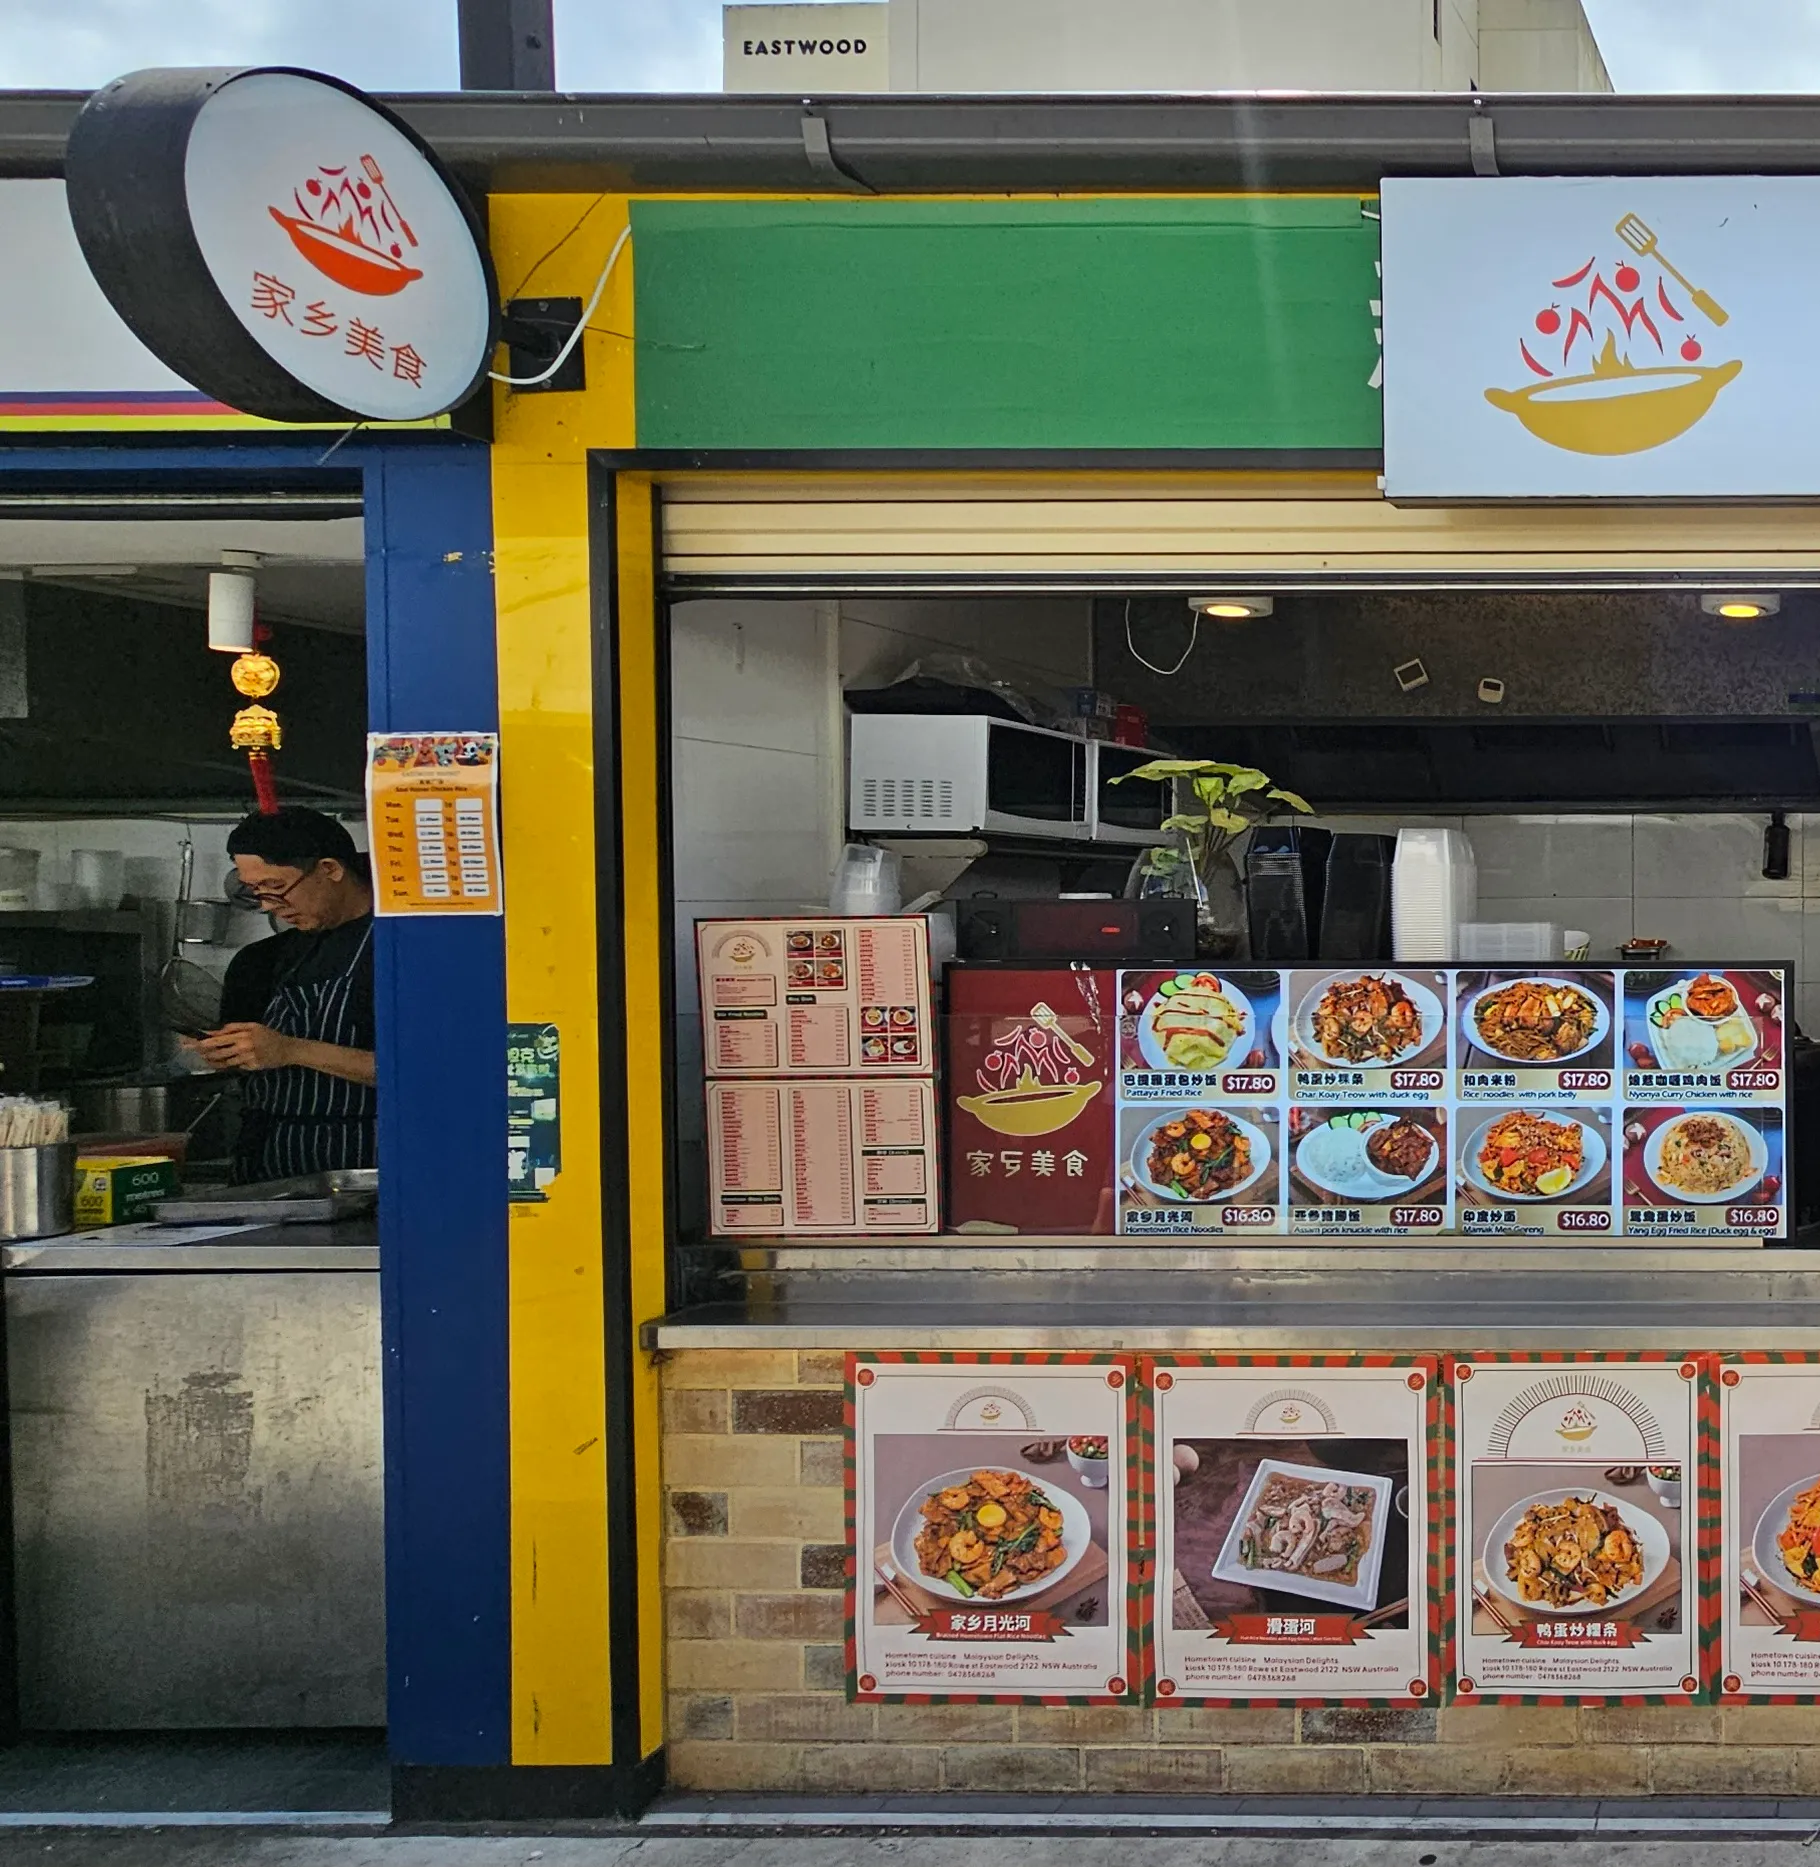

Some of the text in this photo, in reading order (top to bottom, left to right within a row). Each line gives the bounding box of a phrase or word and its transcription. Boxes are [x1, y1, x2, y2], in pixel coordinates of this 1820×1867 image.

[743, 39, 867, 55] EASTWOOD
[251, 270, 428, 389] 家乡美食
[1227, 1077, 1272, 1089] $17.80
[1395, 1073, 1440, 1086] $17.80
[1464, 1075, 1516, 1086] 扣肉米粉
[1563, 1073, 1608, 1086] $17.80
[1731, 1074, 1776, 1087] $17.80
[1126, 1089, 1158, 1098] Pattaya
[1161, 1089, 1182, 1097] Fried
[1318, 1091, 1340, 1099] Koay
[1412, 1092, 1429, 1100] egg
[1538, 1091, 1556, 1099] pork
[1558, 1091, 1577, 1100] belly
[1629, 1091, 1660, 1099] Nyonya
[1662, 1091, 1683, 1099] Curry
[132, 1172, 159, 1186] 600
[80, 1196, 103, 1207] 600
[1126, 1211, 1193, 1223] 家乡月光河
[1225, 1210, 1271, 1223] $16.80
[1395, 1210, 1440, 1223] $17.80
[1463, 1210, 1516, 1222] 印度炒面
[1563, 1214, 1609, 1227] $16.80
[1731, 1209, 1777, 1223] $16.80
[1322, 1226, 1339, 1234] pork
[1514, 1226, 1544, 1235] Goreng
[1628, 1227, 1649, 1235] Yang
[1650, 1227, 1666, 1236] Egg
[1708, 1227, 1731, 1235] (Duck
[1759, 1228, 1777, 1236] egg)
[950, 1614, 1032, 1631] 家乡月光河
[1267, 1617, 1316, 1635] 滑蛋河
[1751, 1652, 1794, 1660] Hometown
[1751, 1670, 1775, 1678] phone
